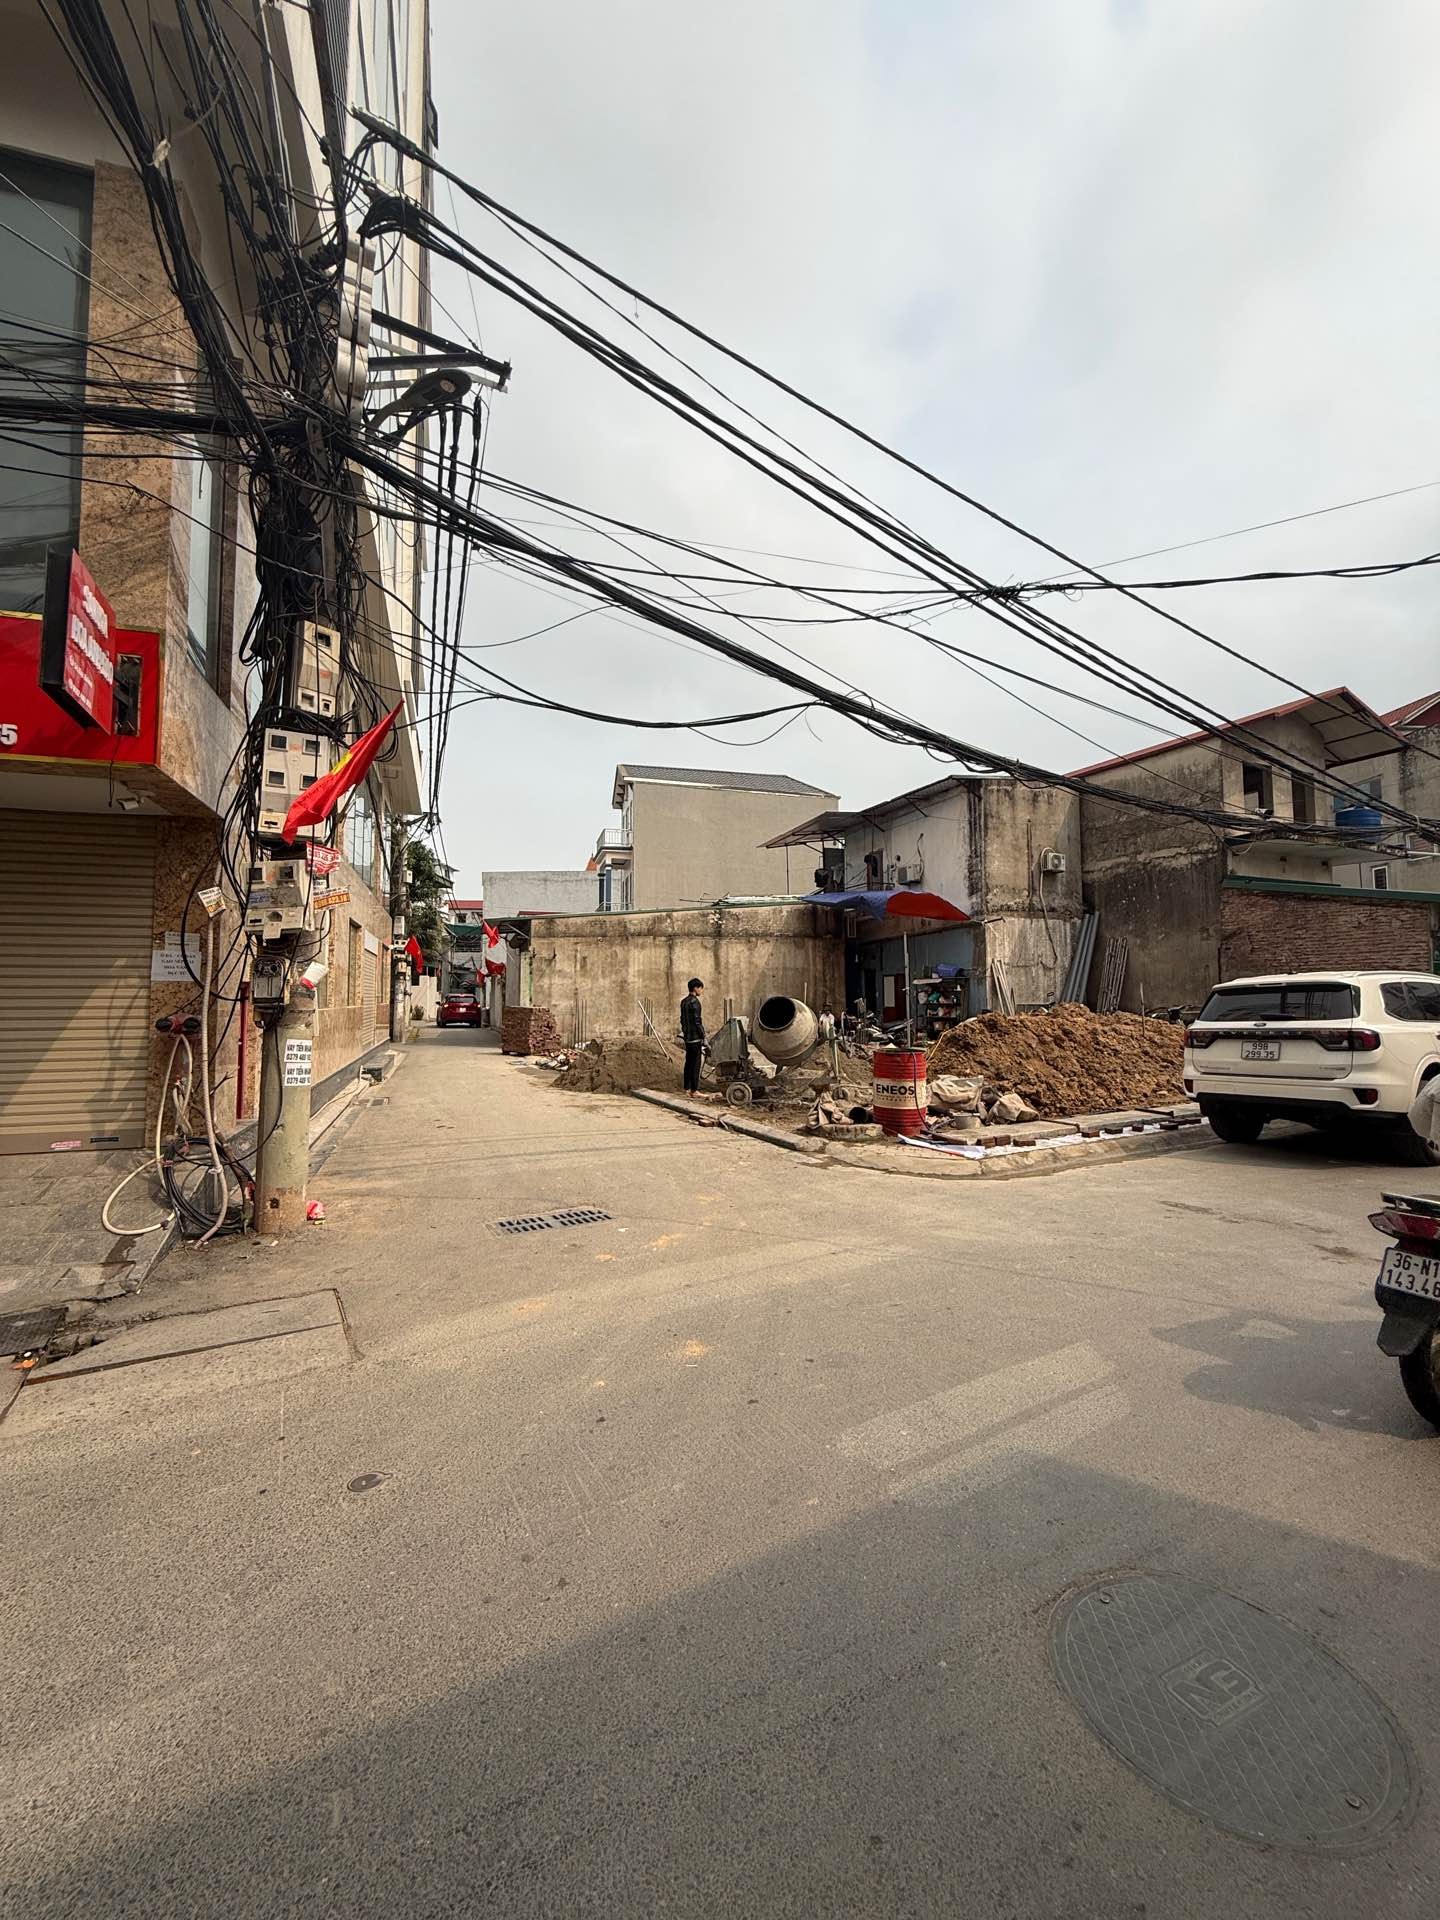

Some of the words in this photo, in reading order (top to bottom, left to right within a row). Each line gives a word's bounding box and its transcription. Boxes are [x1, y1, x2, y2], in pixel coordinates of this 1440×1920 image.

[0, 723, 18, 745] 5
[1245, 1050, 1275, 1059] 299.35
[876, 1083, 915, 1095] ENEOS
[1392, 1252, 1440, 1279] 36-N1
[1386, 1269, 1440, 1298] 143.46
